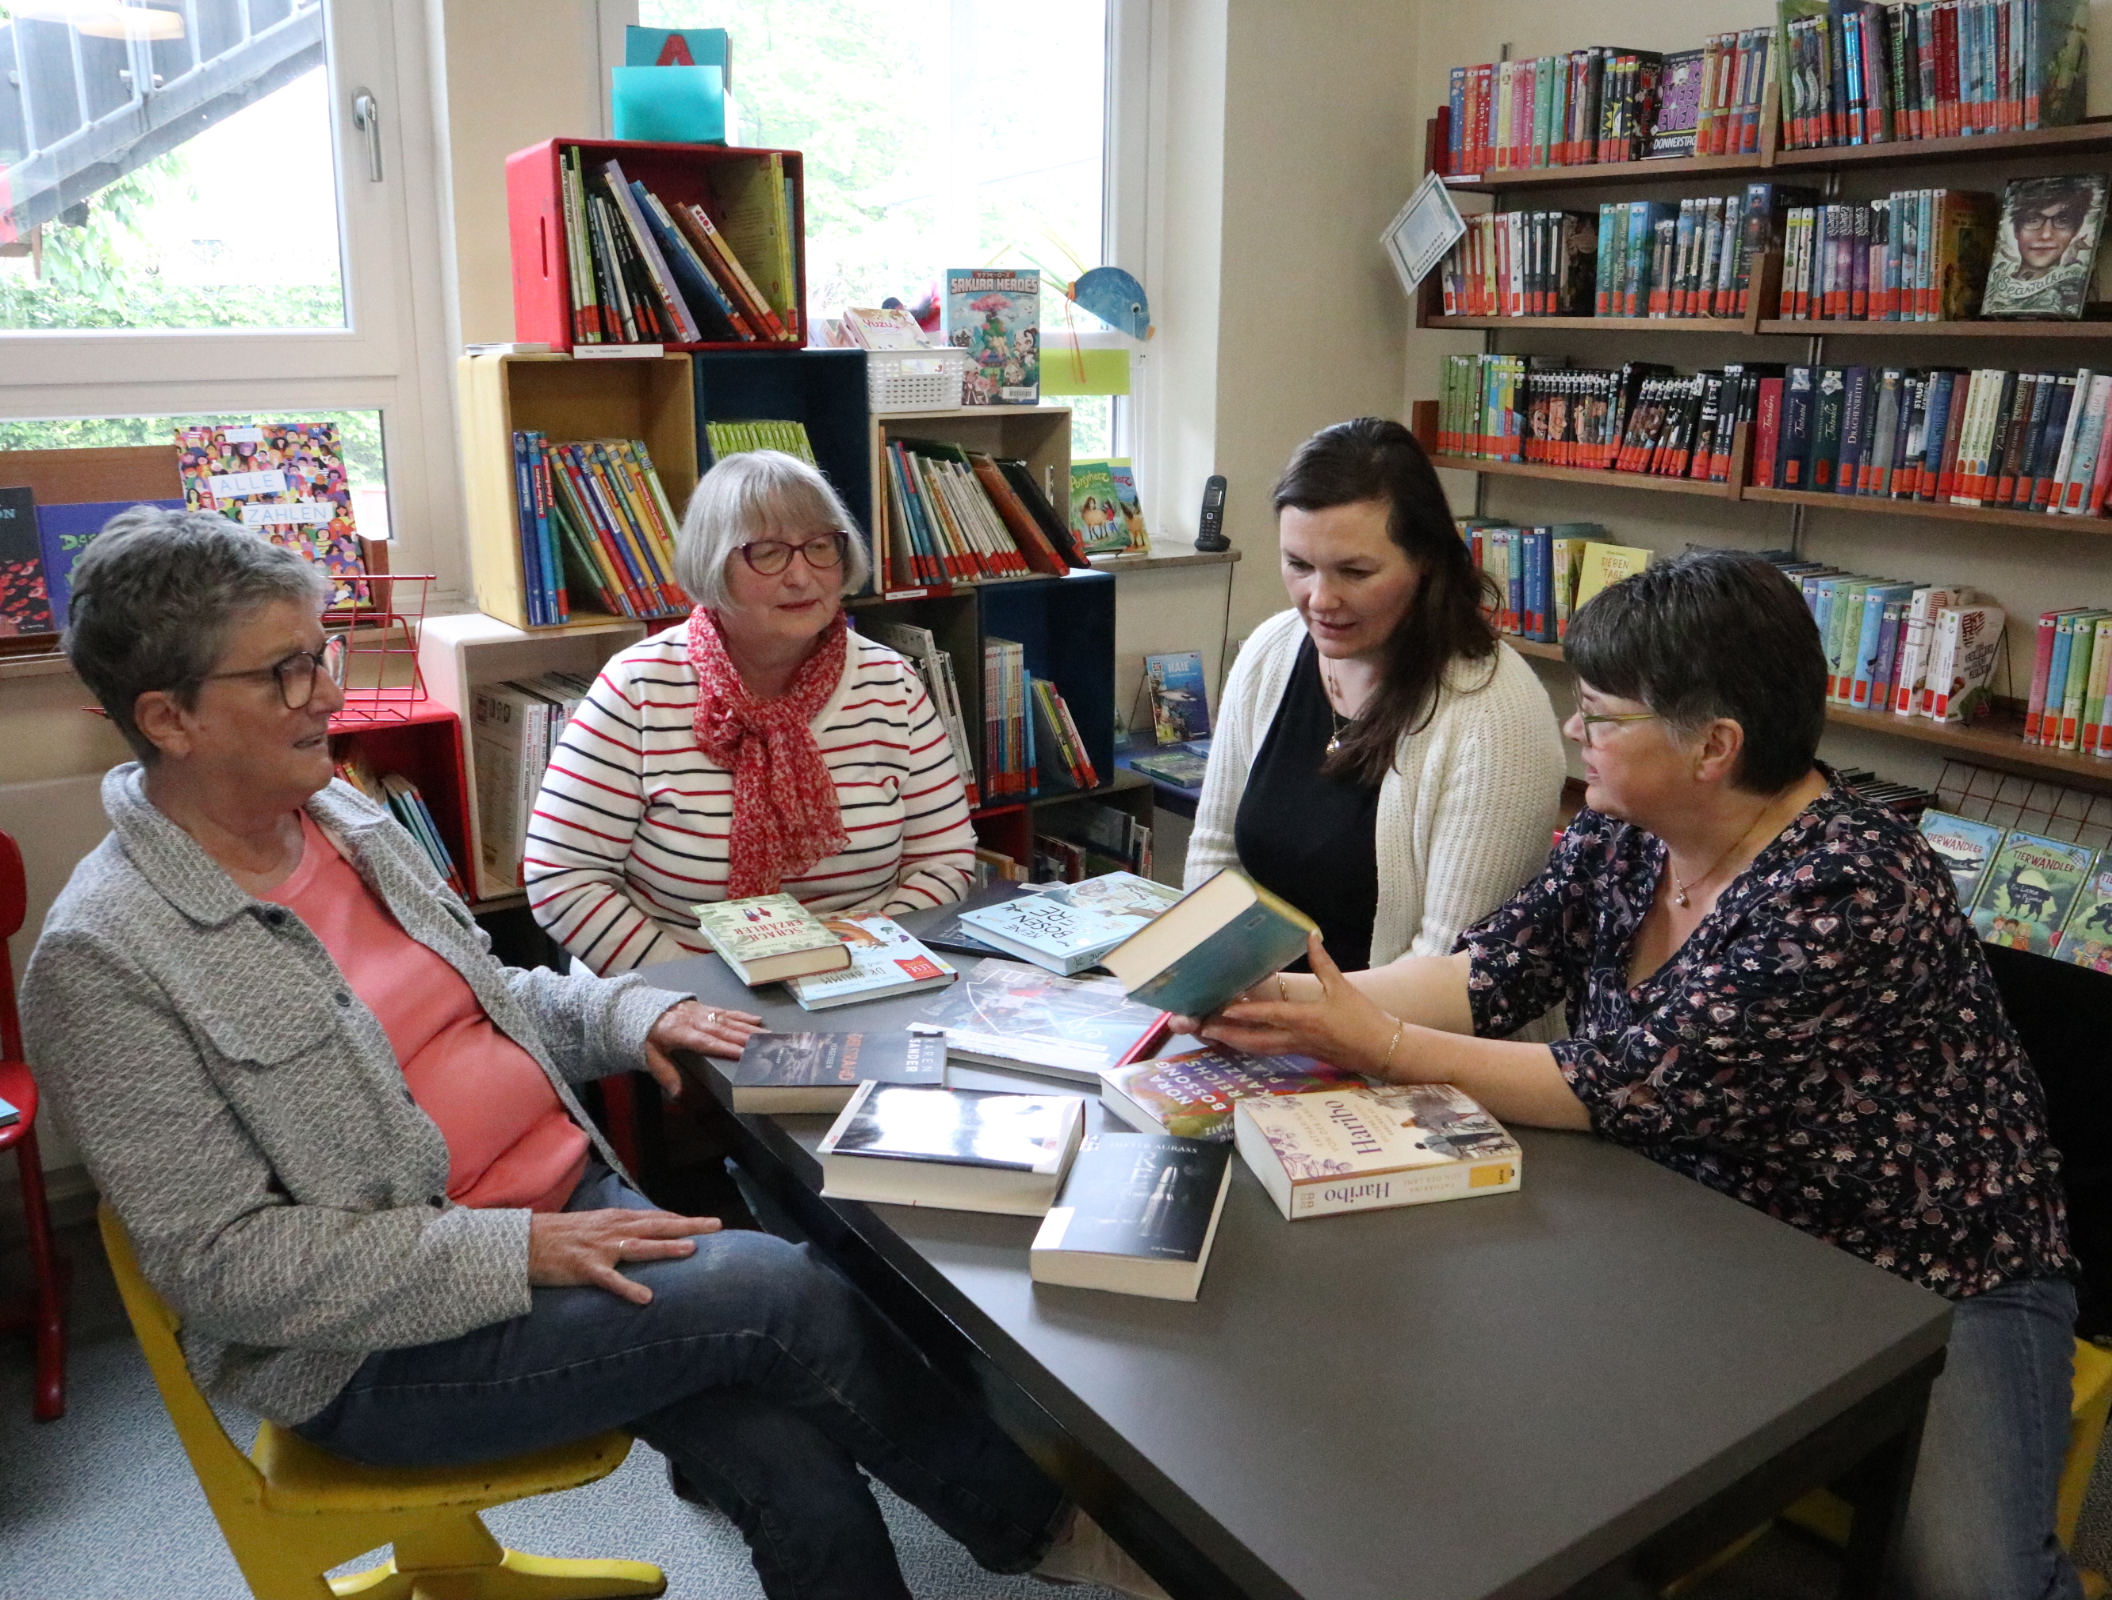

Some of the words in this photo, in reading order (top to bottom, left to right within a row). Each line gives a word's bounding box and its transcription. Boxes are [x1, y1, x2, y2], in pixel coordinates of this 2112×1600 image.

[695, 209, 713, 234] TOPP
[951, 278, 994, 294] SAKURA
[996, 278, 1038, 294] HEROES
[1914, 382, 1924, 409] STAUB
[1763, 395, 1774, 433] Tintenherz
[221, 474, 273, 492] ALLE
[249, 507, 326, 523] ZÄHLEN
[1601, 557, 1630, 569] SIEBEN
[1603, 569, 1624, 579] TAGE
[1168, 662, 1190, 673] HAIE
[1926, 832, 1983, 854] TIERWANDLER
[2013, 850, 2075, 873] TIERWANDLER
[2020, 884, 2040, 895] Lama
[733, 919, 804, 935] ERZÄHLER
[749, 927, 803, 942] SCHACH
[1003, 923, 1043, 939] KEINE
[1011, 915, 1073, 938] BÖSEN
[820, 971, 865, 984] BRUMM
[906, 1038, 921, 1073] SANDER
[922, 1038, 935, 1072] KAREN
[1202, 1051, 1275, 1099] KANZLER
[1234, 1052, 1285, 1084] PLATZ
[1149, 1074, 1193, 1105] NORA
[1155, 1061, 1228, 1111] BOSSONG
[1185, 1060, 1244, 1099] REICHS
[1325, 1101, 1383, 1155] Haribo
[1154, 1143, 1197, 1153] AURASS
[1324, 1182, 1390, 1204] Haribo
